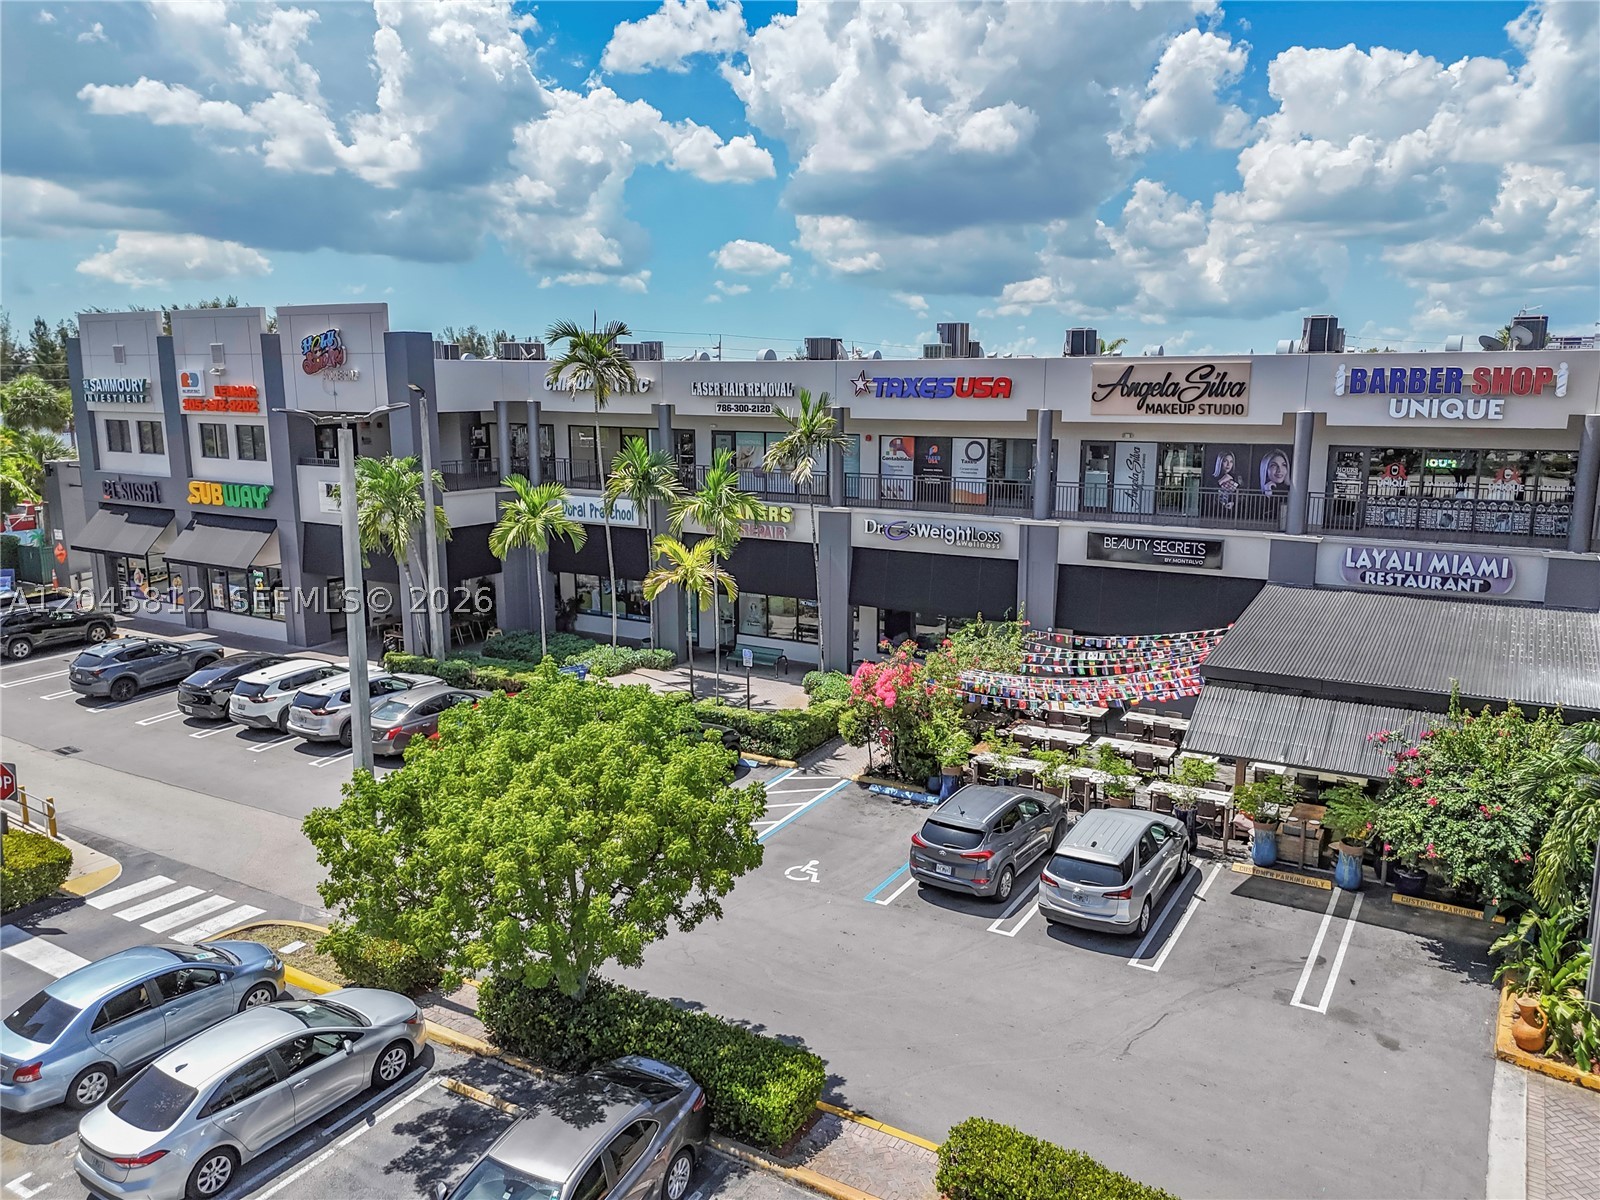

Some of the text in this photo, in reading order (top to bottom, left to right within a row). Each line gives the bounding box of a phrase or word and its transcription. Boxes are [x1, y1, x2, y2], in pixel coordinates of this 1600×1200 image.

[90, 379, 144, 392] SAMMOURY
[691, 382, 794, 397] LASER HAIR REMOVAL
[1092, 364, 1247, 410] Angela Silva
[1349, 366, 1554, 395] BARBER SHOP
[84, 394, 144, 403] INVESTMENT
[716, 403, 771, 413] 786-300-2120
[1389, 398, 1505, 420] UNIQUE
[1145, 404, 1245, 415] MAKEUP STUDIO
[187, 481, 272, 510] SUBWAY
[1104, 537, 1206, 555] BEAUTY SECRETS
[1172, 558, 1204, 566] MONTALVO
[1345, 548, 1510, 579] LAYALI MIAMI
[1364, 571, 1484, 593] RESTAURANT
[1239, 865, 1326, 888] CUSTOMER PARKING ONLY
[1401, 896, 1476, 917] CUSTOMER PARKING
